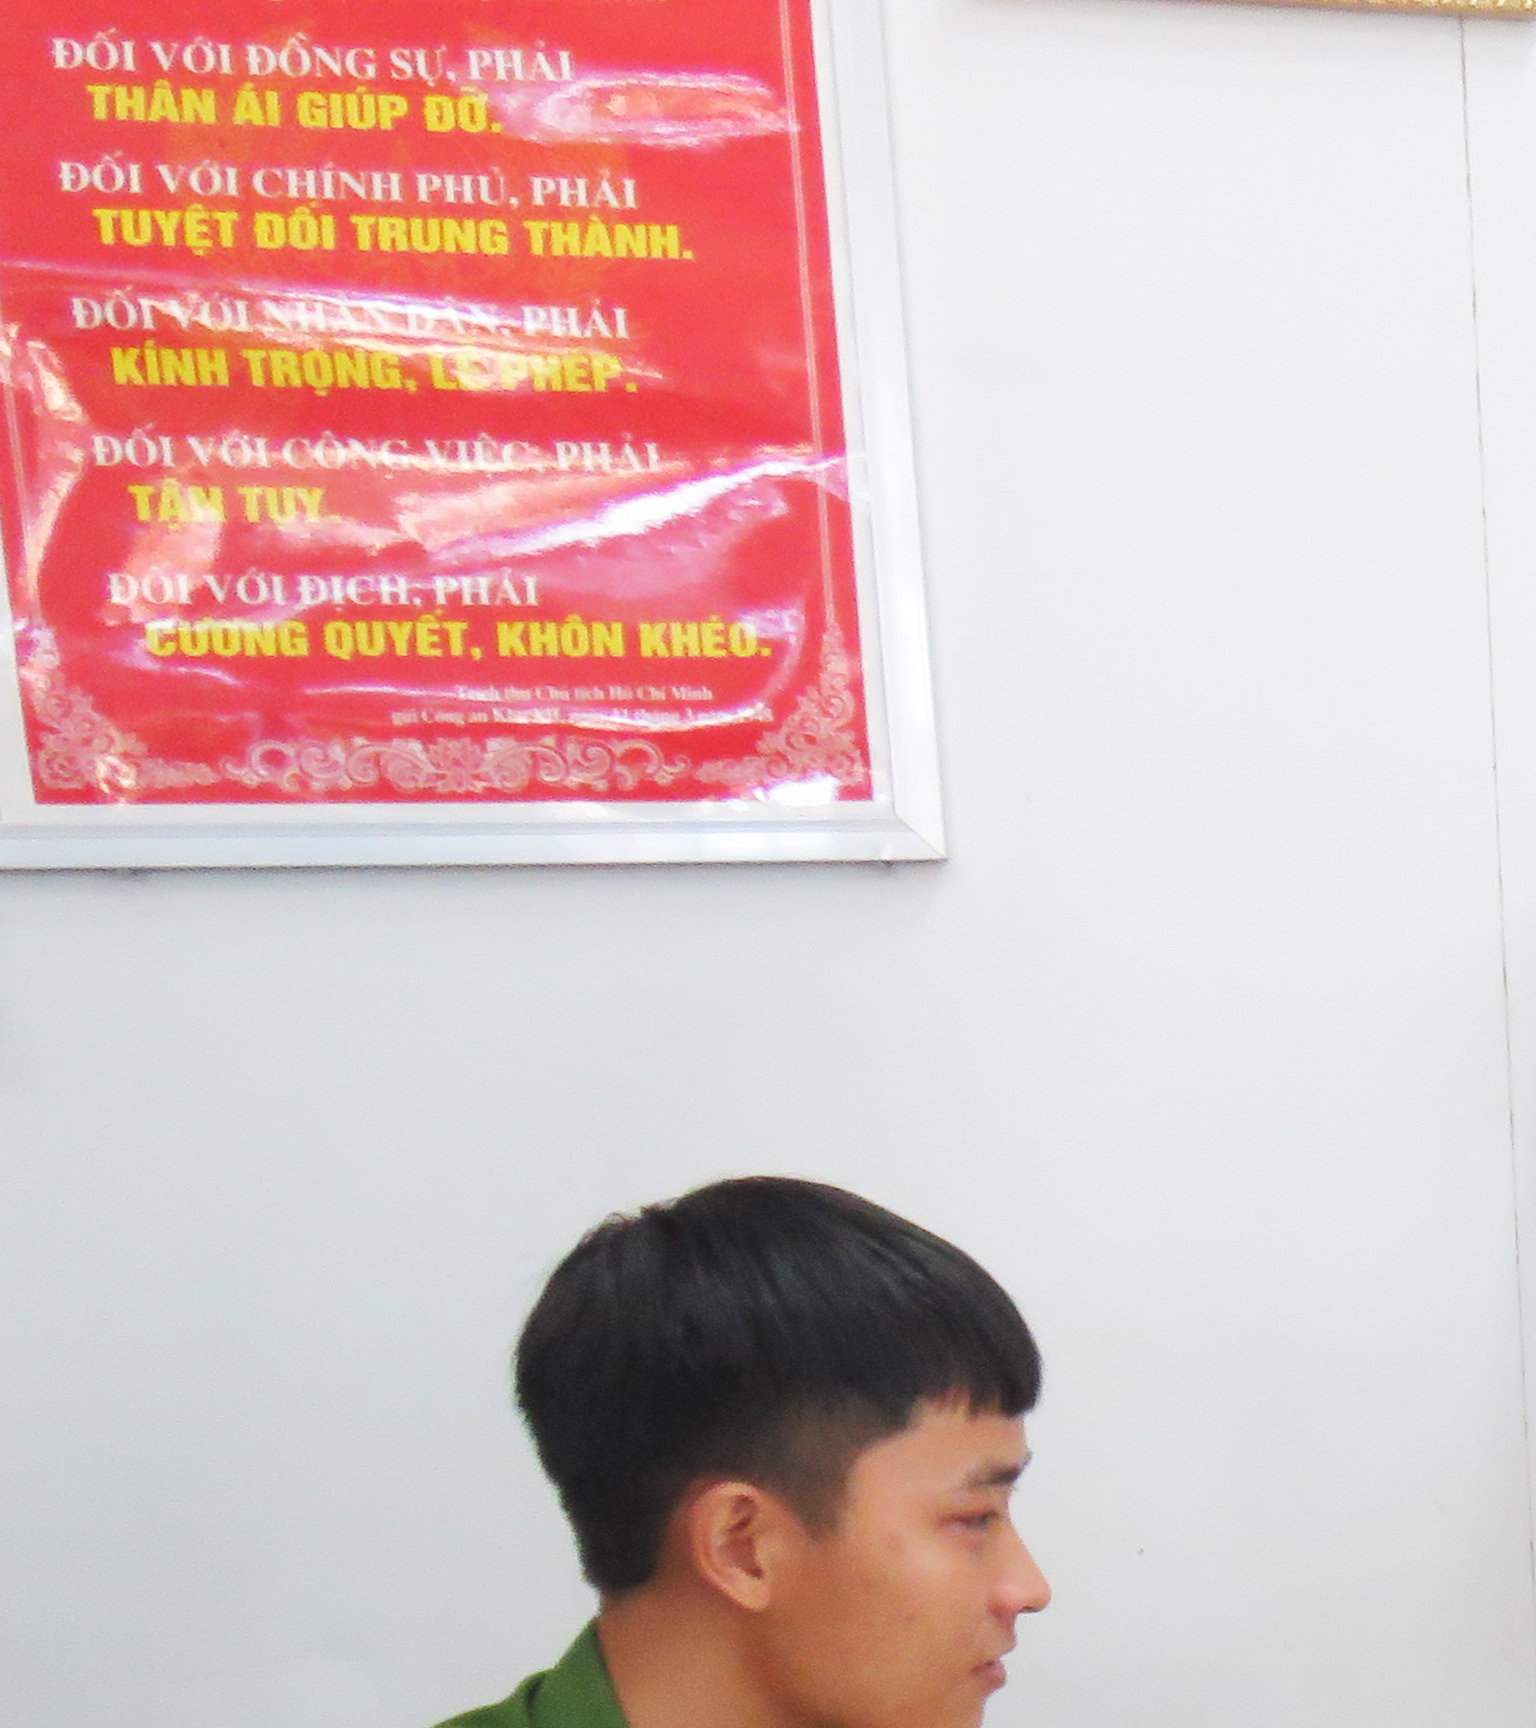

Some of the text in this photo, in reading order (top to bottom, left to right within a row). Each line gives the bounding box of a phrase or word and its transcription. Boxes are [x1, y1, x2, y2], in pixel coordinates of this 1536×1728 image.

[51, 28, 137, 73] ĐỐI
[149, 35, 234, 75] VỚI
[245, 32, 377, 80] ĐỒNG
[466, 39, 575, 82] PHẢI
[86, 78, 217, 125] THÂN
[232, 81, 281, 127] ÁI
[295, 85, 408, 131] GIÚP
[58, 150, 638, 210] ĐỐI VỚI CHÍNH PHỦ, PHẢI
[92, 200, 695, 260] TUYỆT ĐỐI TRUNG THÀNH.
[72, 285, 156, 331] ĐỐI
[521, 297, 631, 340] PHẢI
[110, 339, 231, 387] KÍNH
[240, 348, 418, 398] TRỌNG,
[91, 424, 177, 468] ĐỐI
[280, 429, 413, 472] CÔNG
[555, 430, 665, 475] PHẢI
[126, 477, 226, 531] TẬN
[202, 566, 287, 606] VỚI
[433, 566, 539, 606] PHẢI
[144, 607, 773, 662] CƯƠNG QUYẾT, KHÔN KHÉO.
